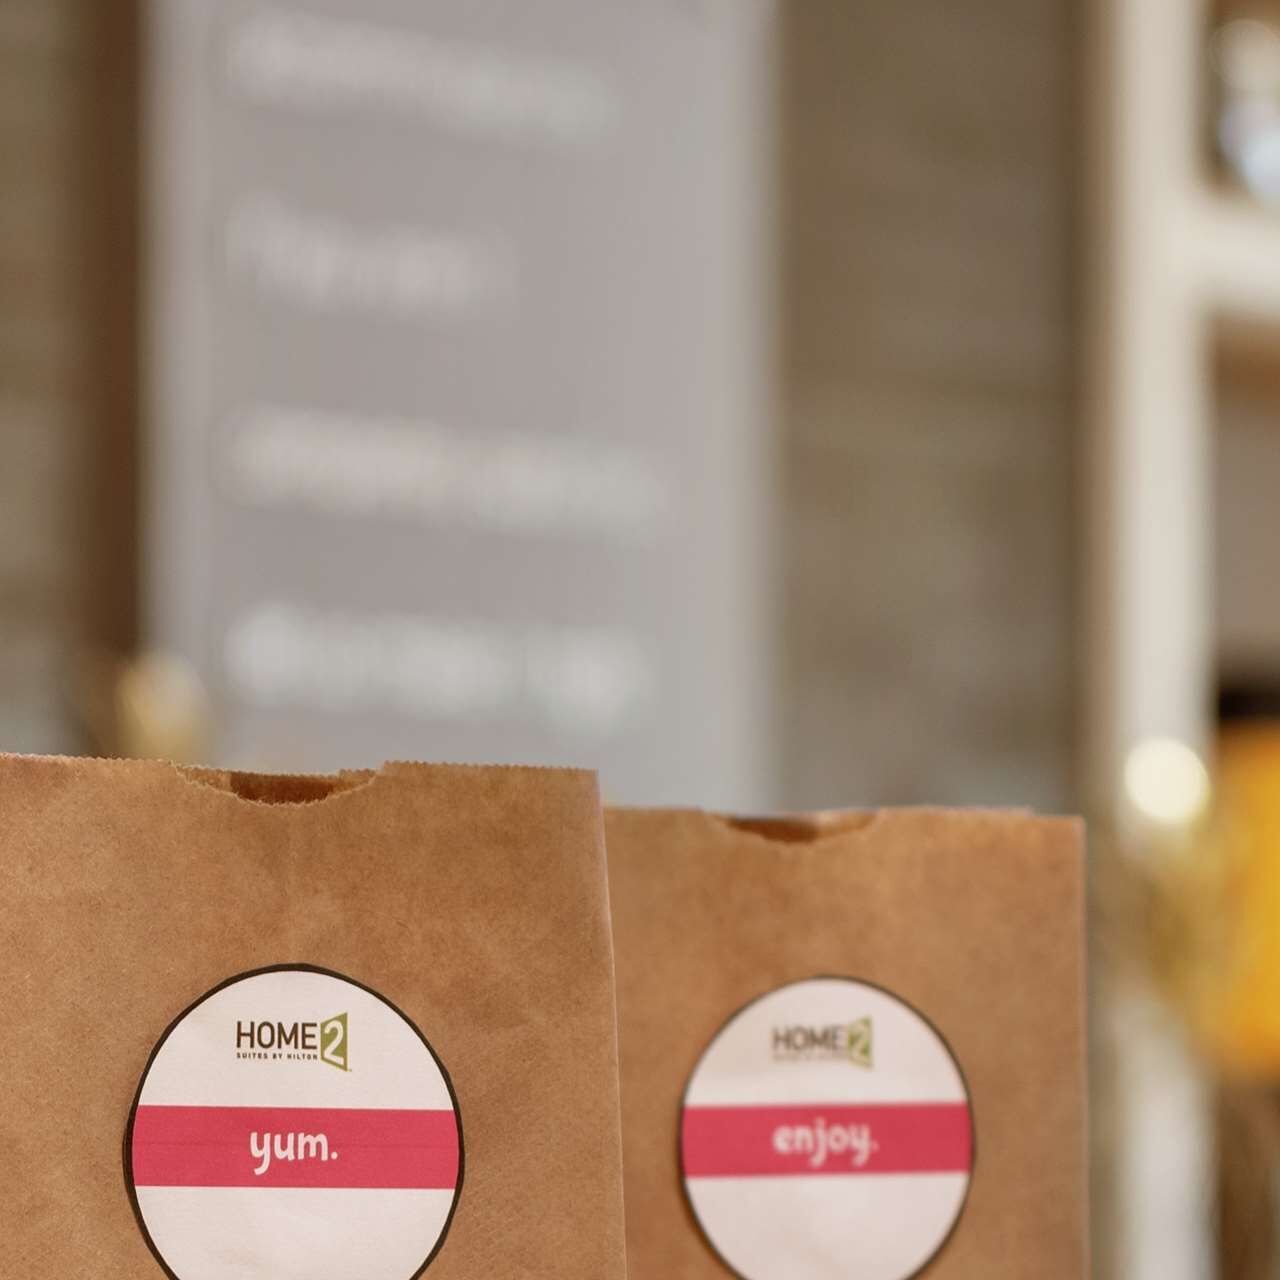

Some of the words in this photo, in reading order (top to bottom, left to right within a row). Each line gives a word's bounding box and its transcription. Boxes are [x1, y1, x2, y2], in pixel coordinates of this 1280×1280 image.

[236, 1014, 347, 1071] HOME2
[236, 1052, 268, 1060] SUITES
[272, 1052, 283, 1060] BY
[287, 1053, 318, 1061] HILTON
[250, 1132, 338, 1176] yum.
[773, 1117, 880, 1169] enjoy.
